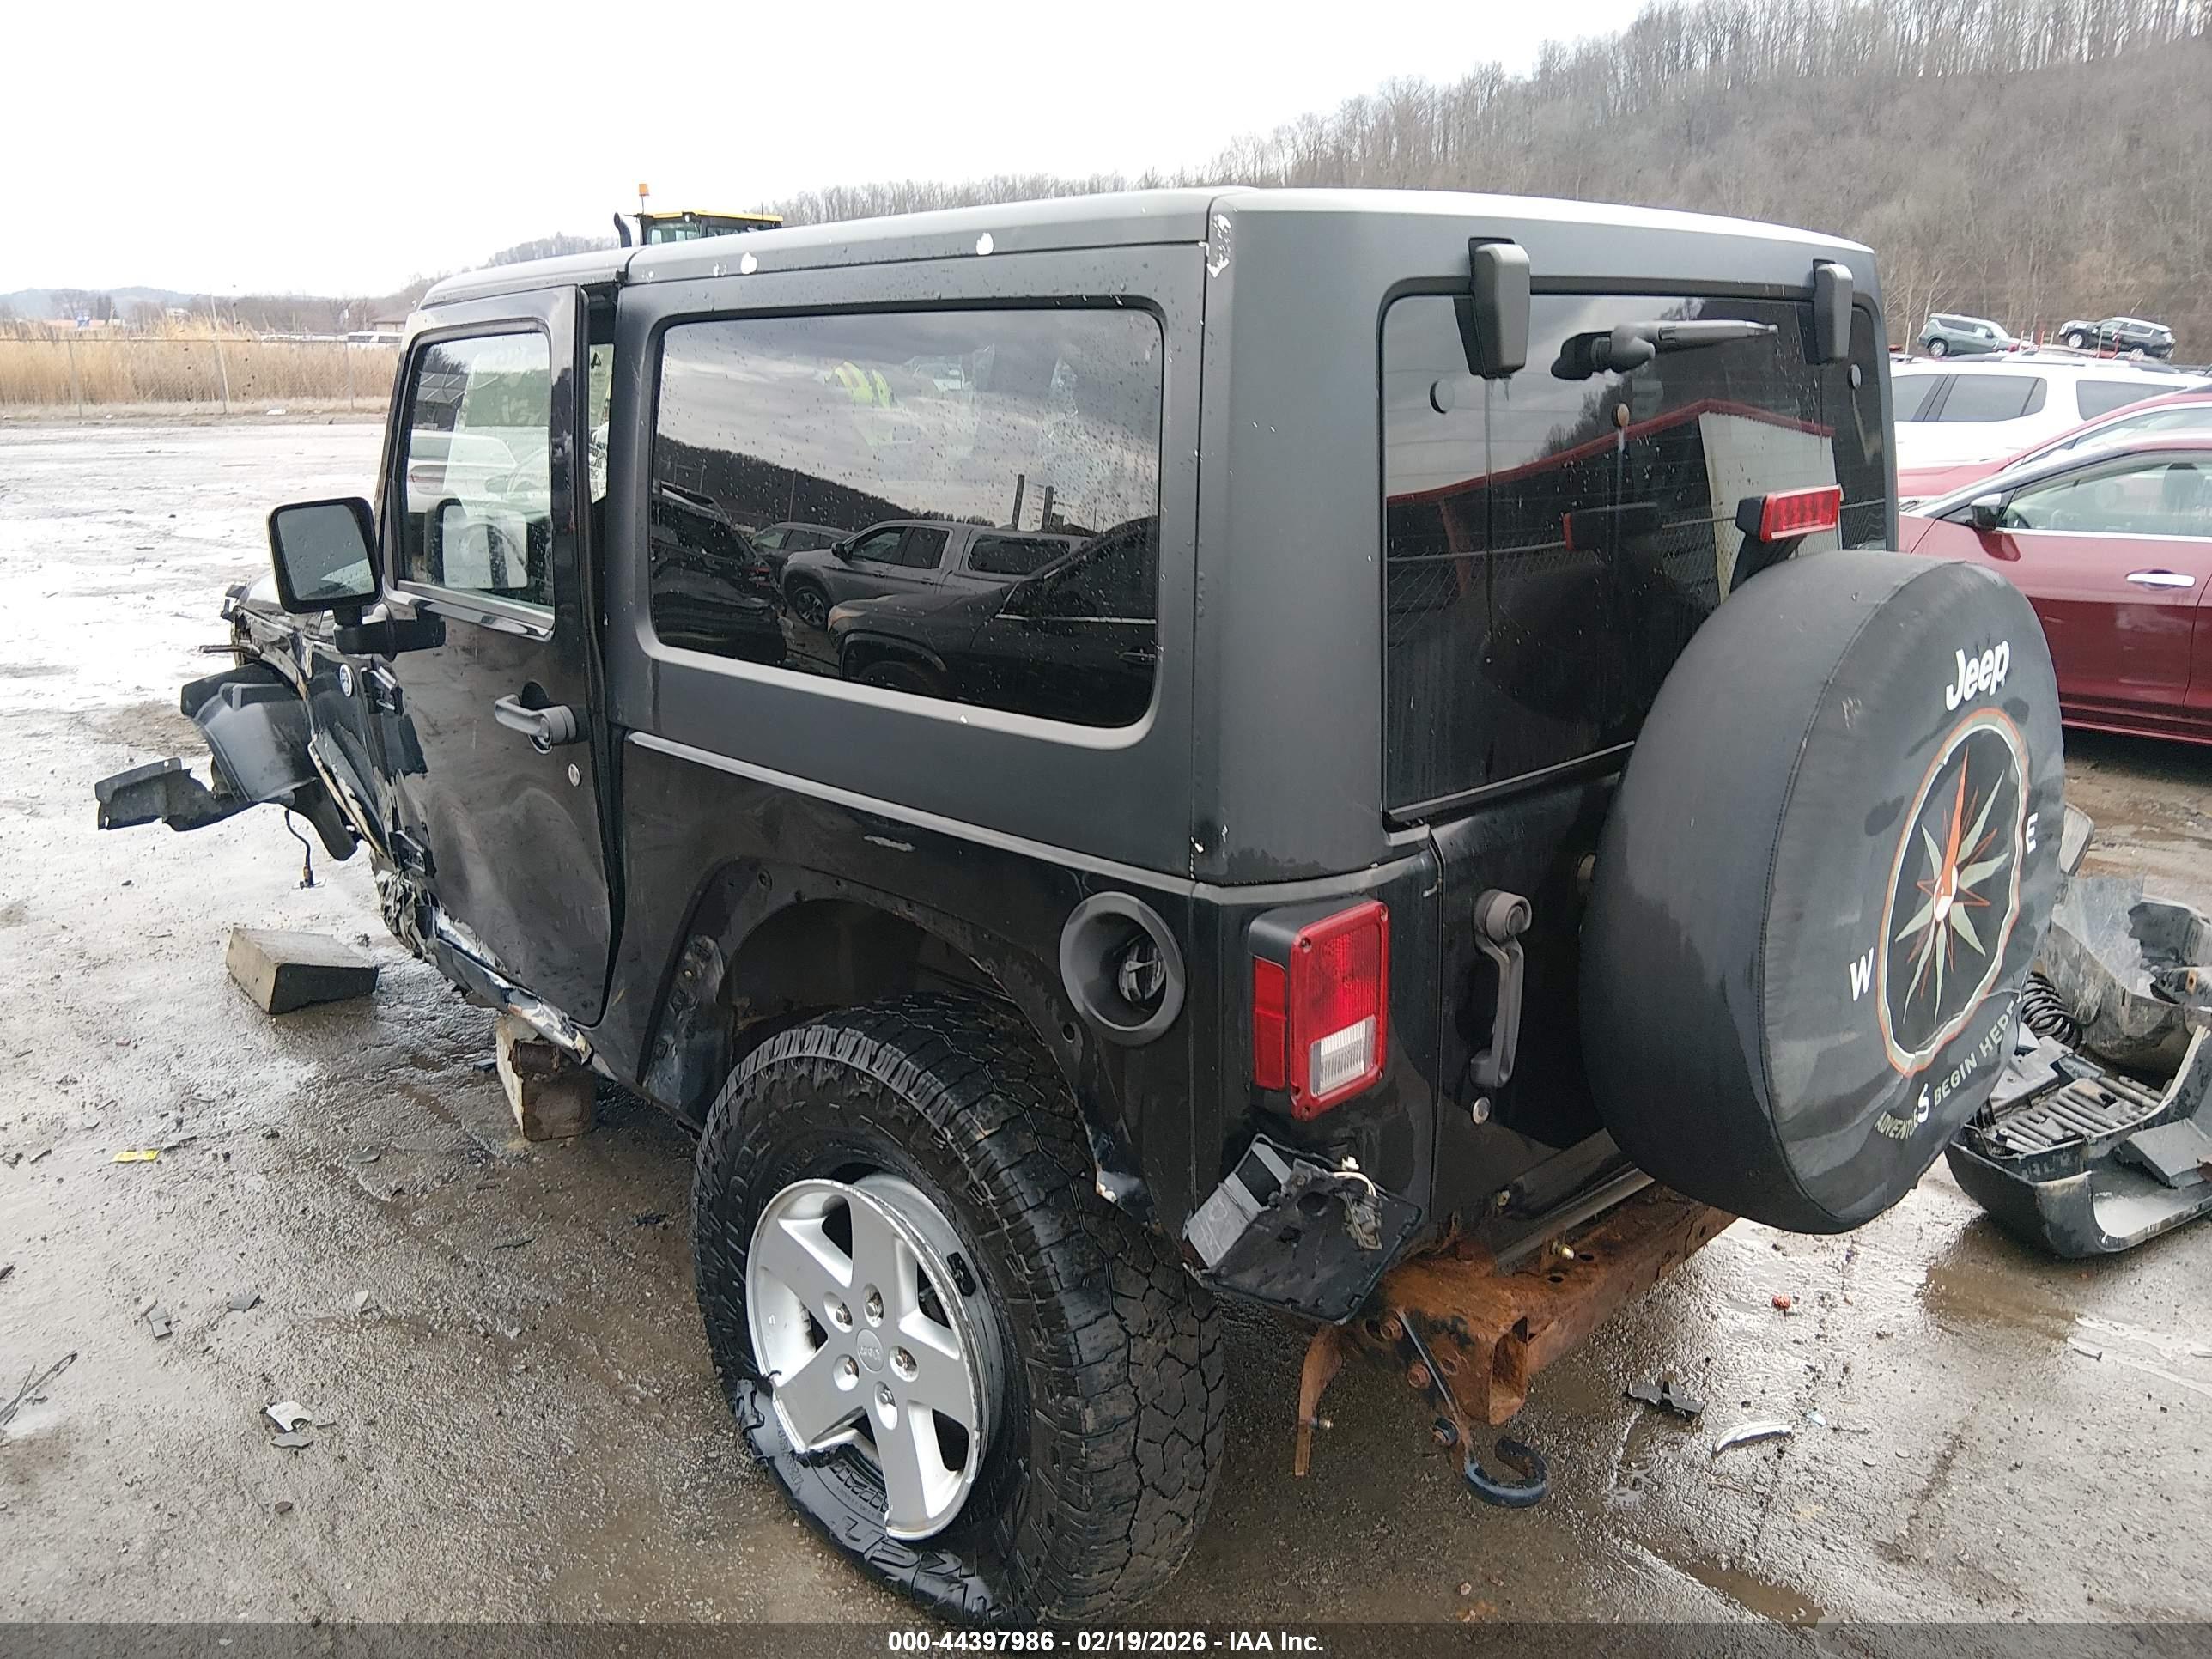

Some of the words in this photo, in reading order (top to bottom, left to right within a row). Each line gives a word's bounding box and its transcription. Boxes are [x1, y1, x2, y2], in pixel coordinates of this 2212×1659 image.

[1946, 640, 2010, 711] Jeep
[2025, 812, 2039, 854] E
[1850, 947, 1875, 1001] W
[1934, 1051, 1978, 1108] BEGIN
